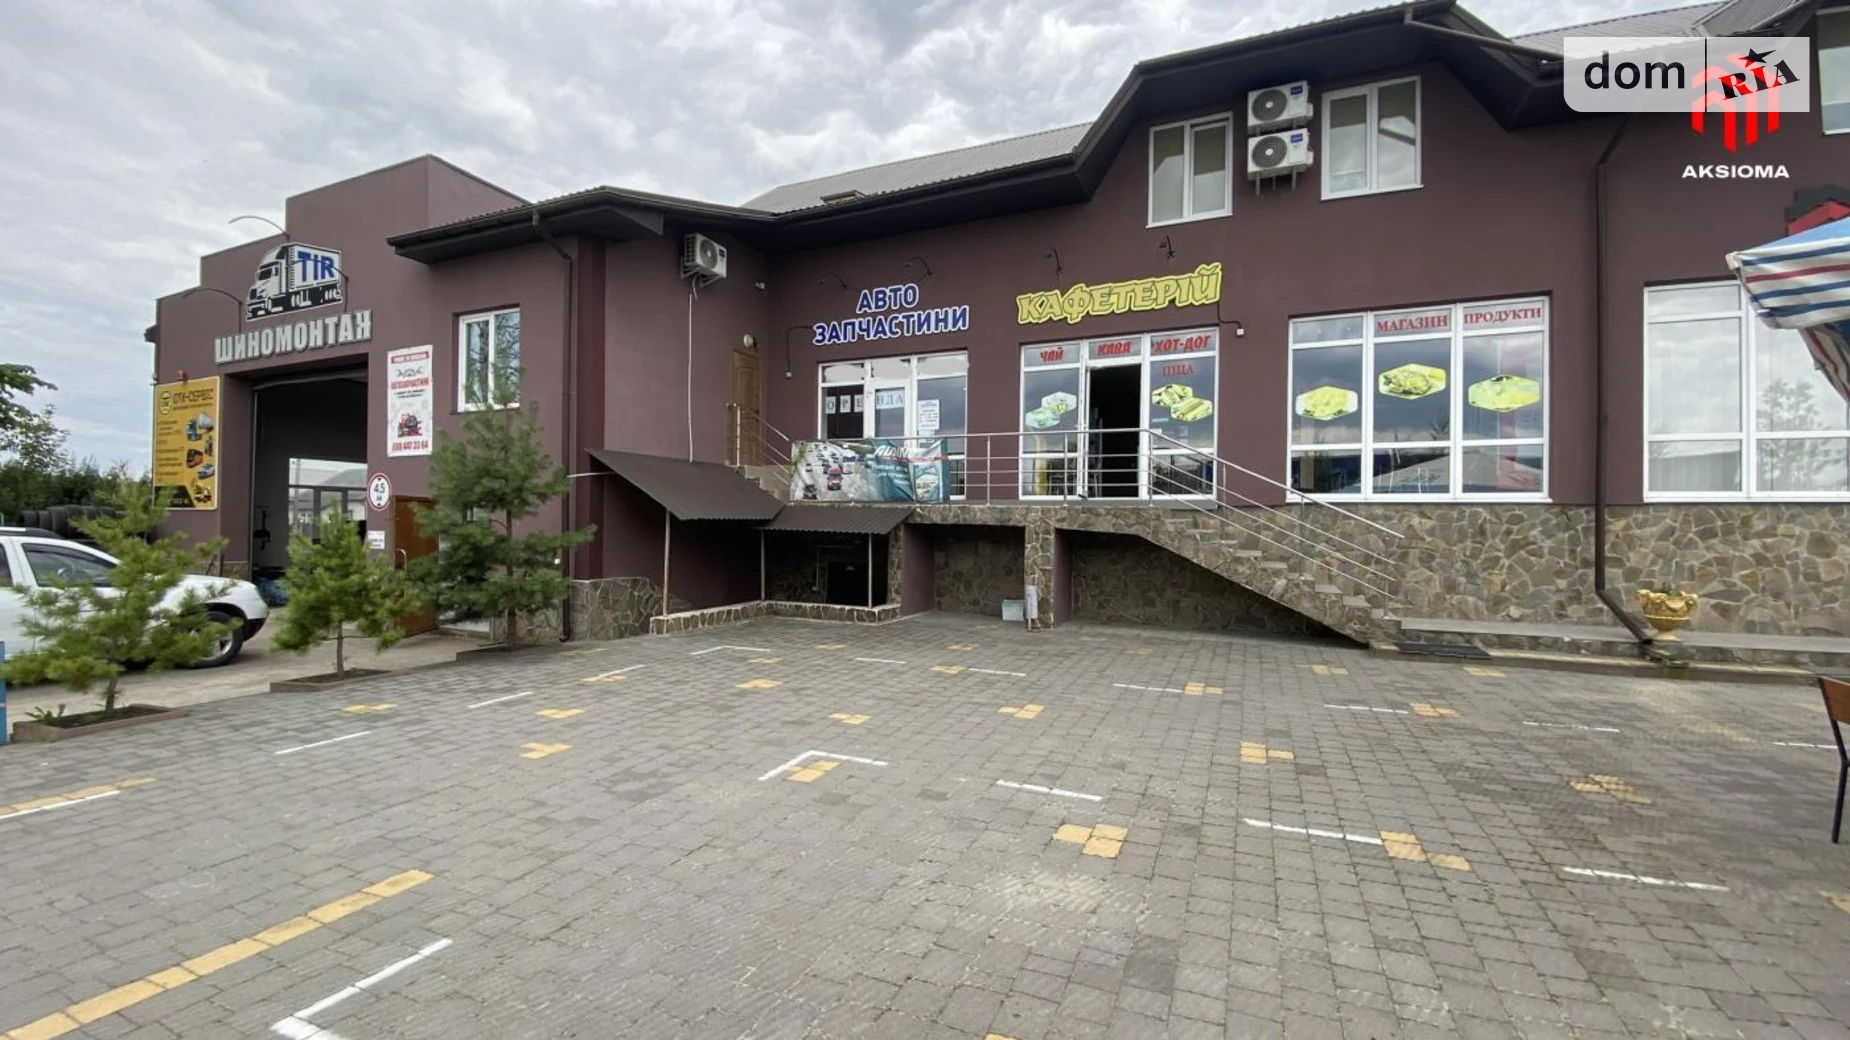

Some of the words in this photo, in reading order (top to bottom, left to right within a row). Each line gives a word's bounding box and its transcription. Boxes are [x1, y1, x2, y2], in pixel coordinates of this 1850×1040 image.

[297, 251, 335, 282] TIR
[856, 284, 919, 314] АВТО
[1016, 262, 1222, 324] КАФЕТЕРІЙ
[813, 305, 969, 346] ЗАПЧАСТИНИ
[1376, 315, 1448, 333] МАГАЗИН
[1462, 307, 1542, 325] ПРОДУКТИ
[1039, 346, 1065, 362] ЧАЙ
[1097, 340, 1132, 357] КАВА
[1153, 335, 1211, 354] ХОТ-ДОГ
